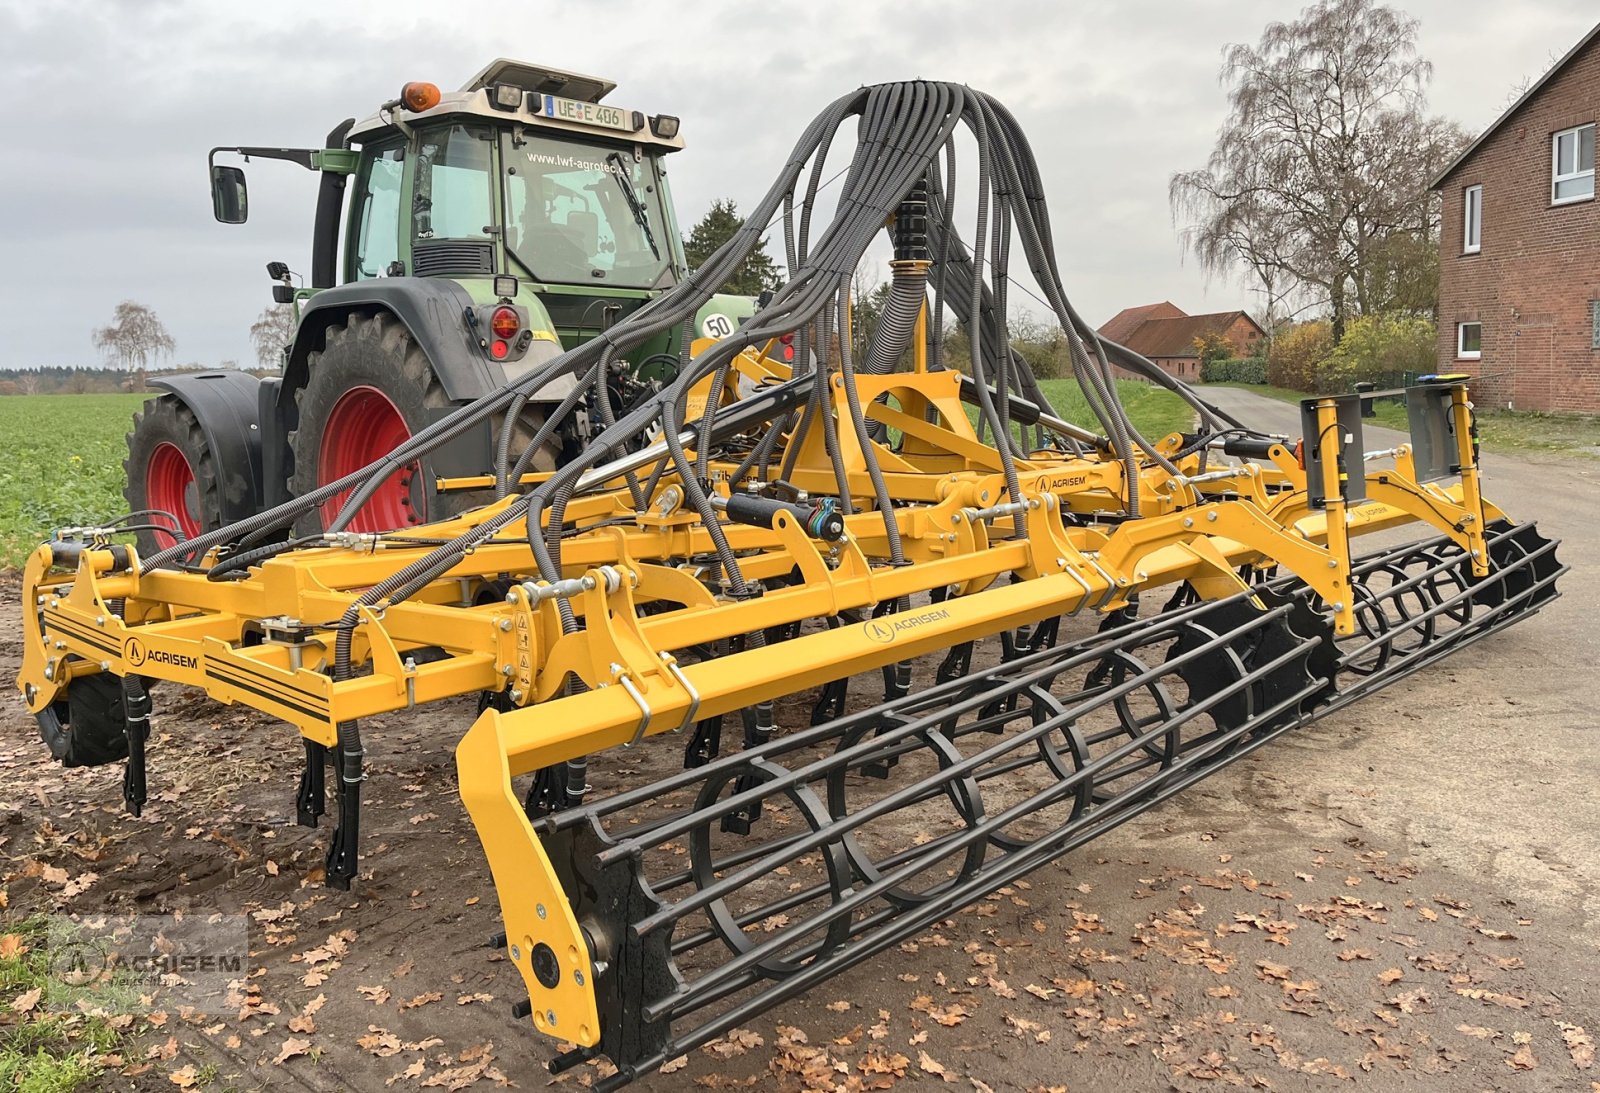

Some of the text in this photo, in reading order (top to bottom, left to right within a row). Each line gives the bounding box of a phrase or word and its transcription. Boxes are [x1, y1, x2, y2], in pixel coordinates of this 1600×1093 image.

[558, 101, 619, 125] UE E 406
[706, 316, 731, 338] 50
[1052, 476, 1086, 489] AGRISEM
[894, 609, 950, 632] AGRISEM
[147, 649, 198, 669] AGRISEM
